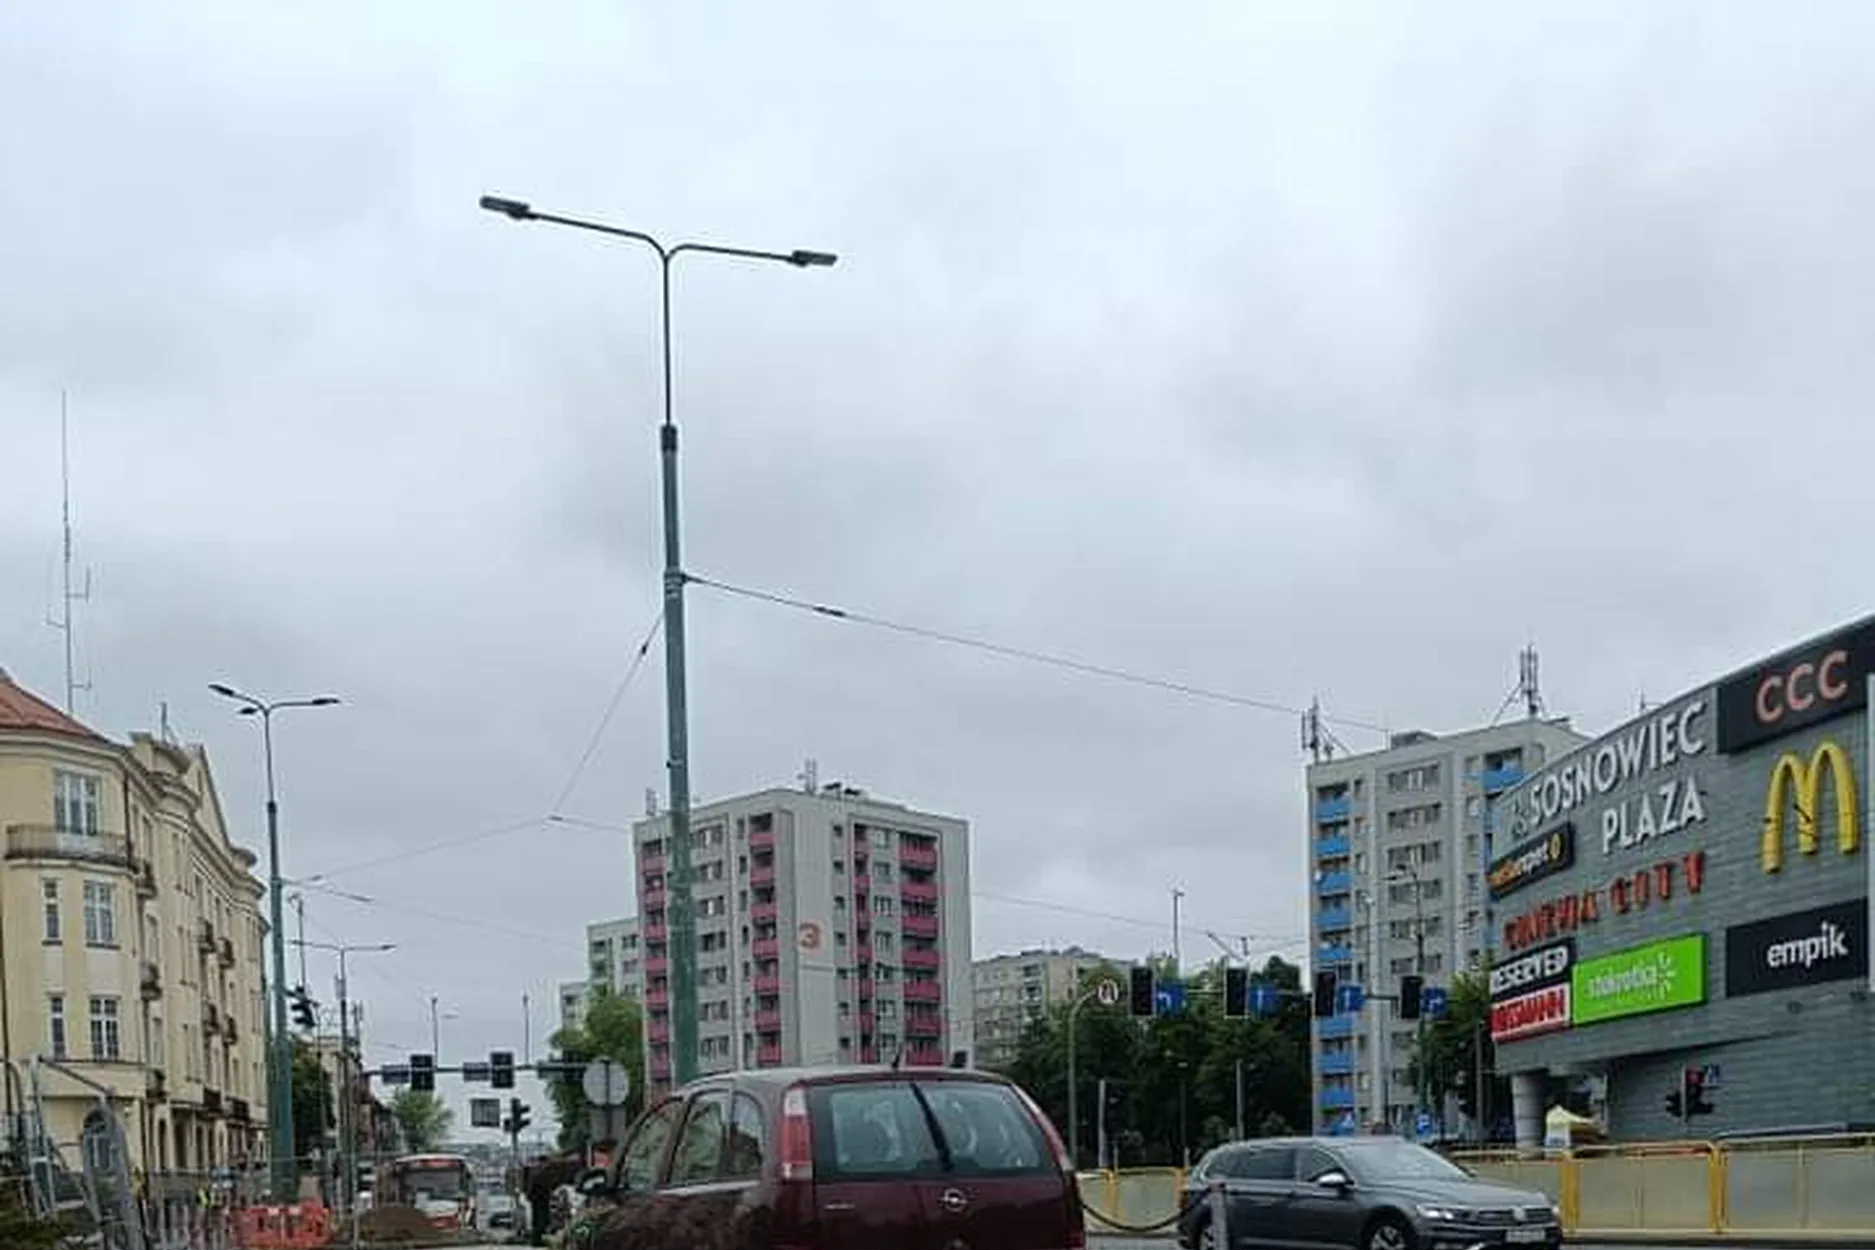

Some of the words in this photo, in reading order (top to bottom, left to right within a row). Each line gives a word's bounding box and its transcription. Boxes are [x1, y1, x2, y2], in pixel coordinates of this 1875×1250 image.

[1755, 649, 1848, 723] CCC
[1530, 701, 1705, 825] SOSNOWIEC
[1603, 775, 1705, 854] PLAZA
[1611, 852, 1705, 914] CITY
[1766, 920, 1849, 969] empik
